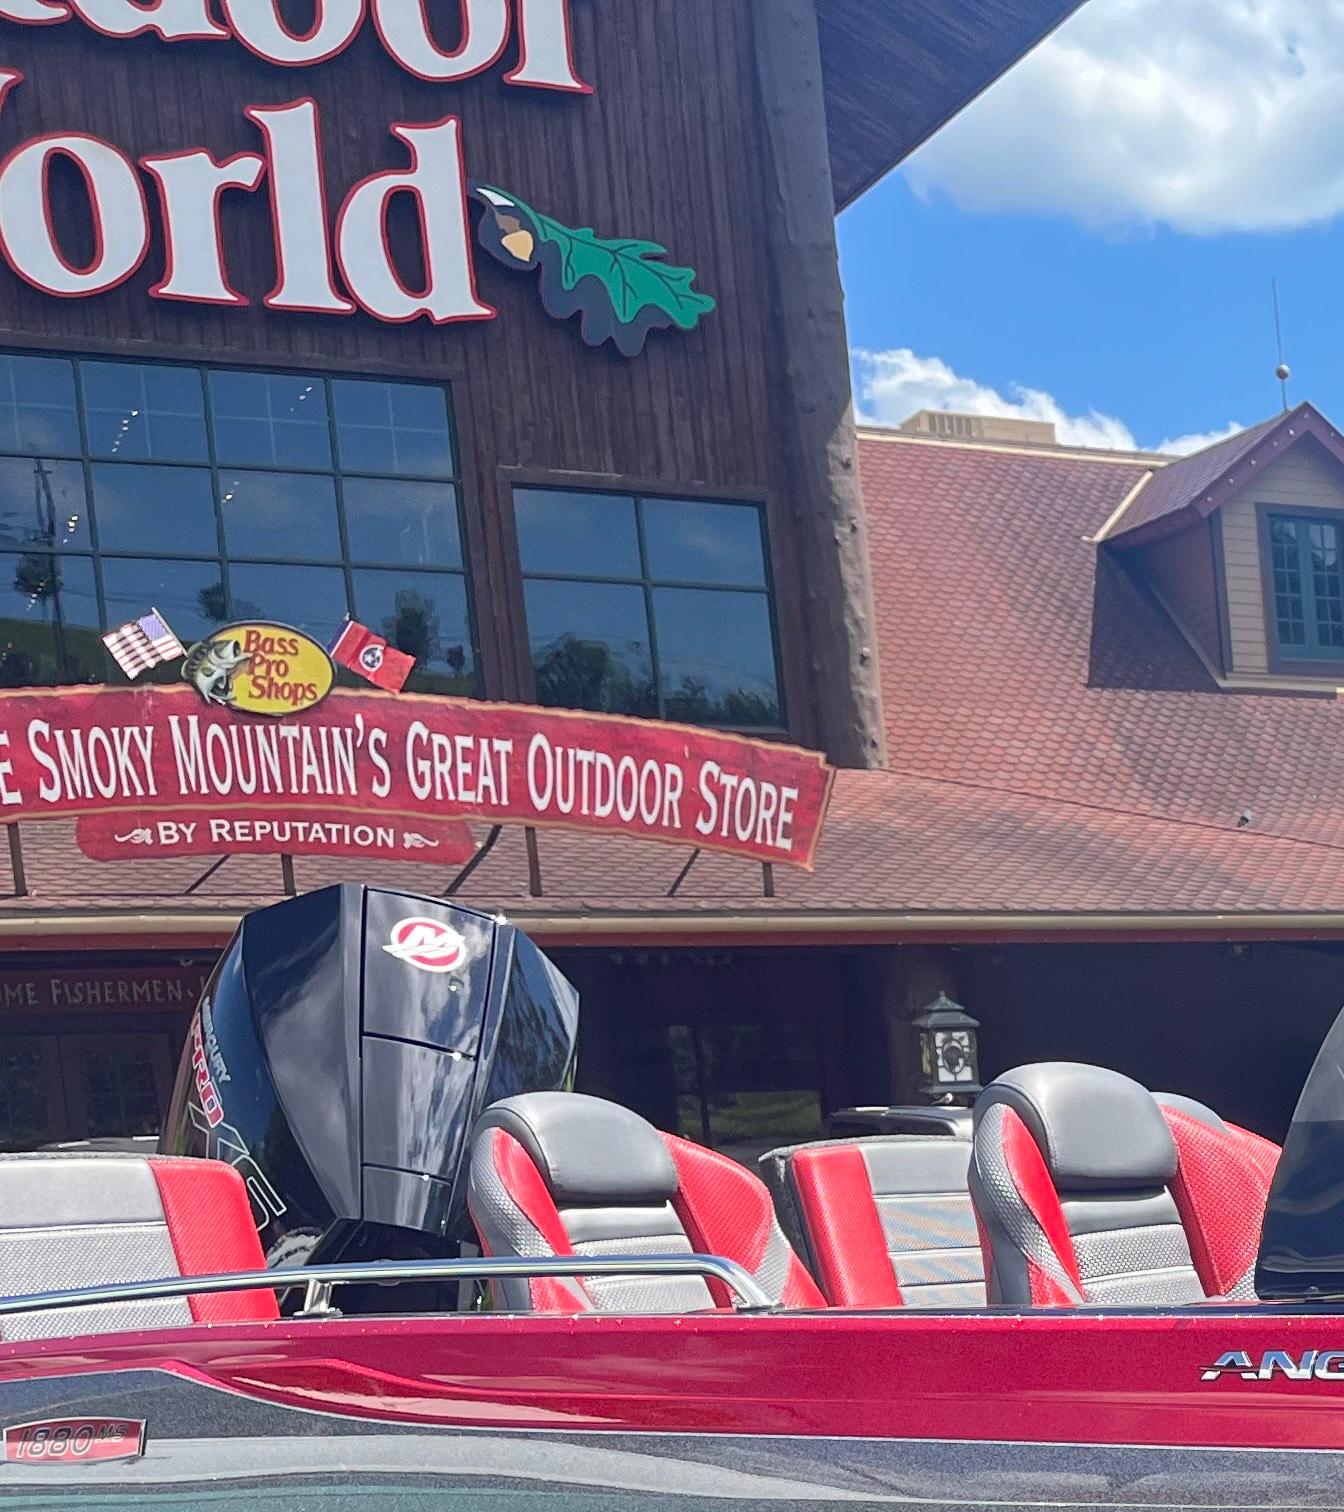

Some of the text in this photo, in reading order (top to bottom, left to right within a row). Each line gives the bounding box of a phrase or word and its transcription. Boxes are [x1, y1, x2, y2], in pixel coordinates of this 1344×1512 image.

[0, 68, 498, 325] orld
[243, 630, 299, 656] Bass
[248, 653, 290, 678] Pro
[249, 675, 318, 706] Shops
[27, 718, 159, 803] SMOKY
[168, 713, 392, 799] MOUNTAIN'S
[405, 720, 513, 806] GREAT
[527, 732, 683, 829] OUTDOOR
[695, 760, 799, 851] STORE
[157, 818, 395, 848] BY REPUTATION
